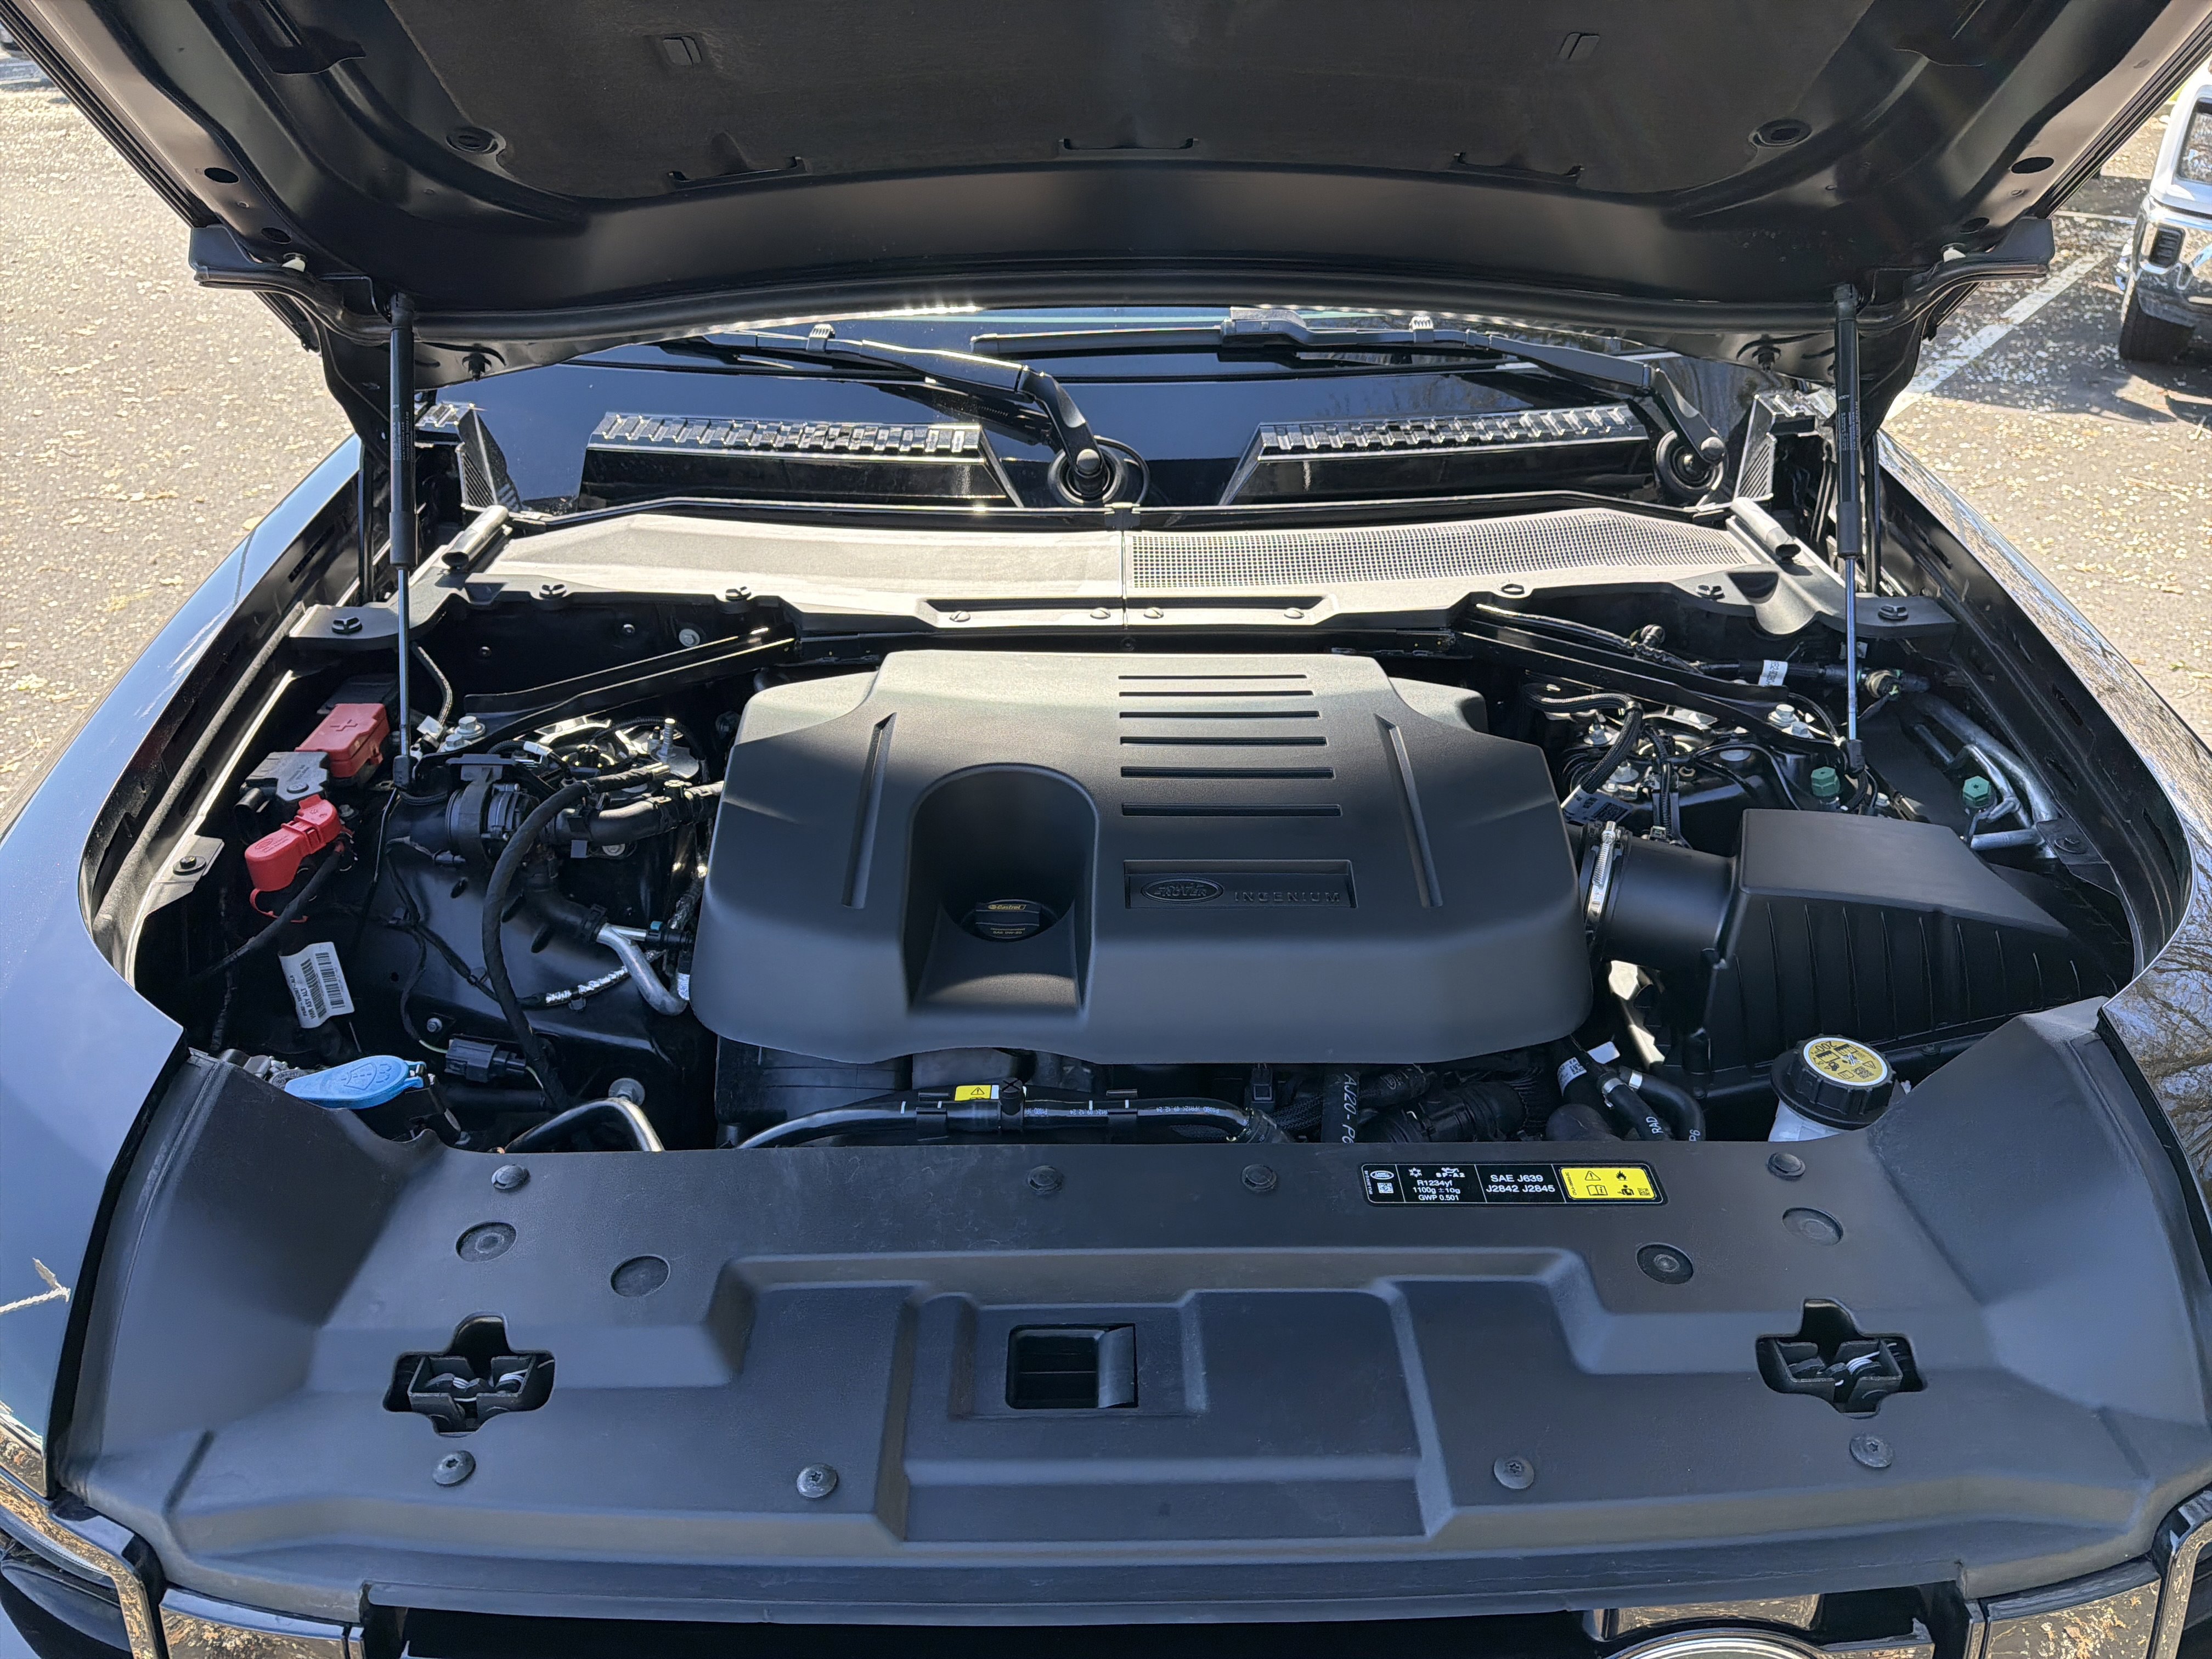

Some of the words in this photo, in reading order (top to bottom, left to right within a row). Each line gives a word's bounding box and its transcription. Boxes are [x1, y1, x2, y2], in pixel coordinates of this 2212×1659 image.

[1234, 891, 1340, 902] INGENIUM
[1815, 1041, 1837, 1052] 200
[1646, 1116, 1664, 1134] RAD
[1490, 1174, 1515, 1182] SAE
[1517, 1174, 1544, 1182] J639
[1486, 1184, 1520, 1193] J2842
[1522, 1184, 1556, 1193] J2845
